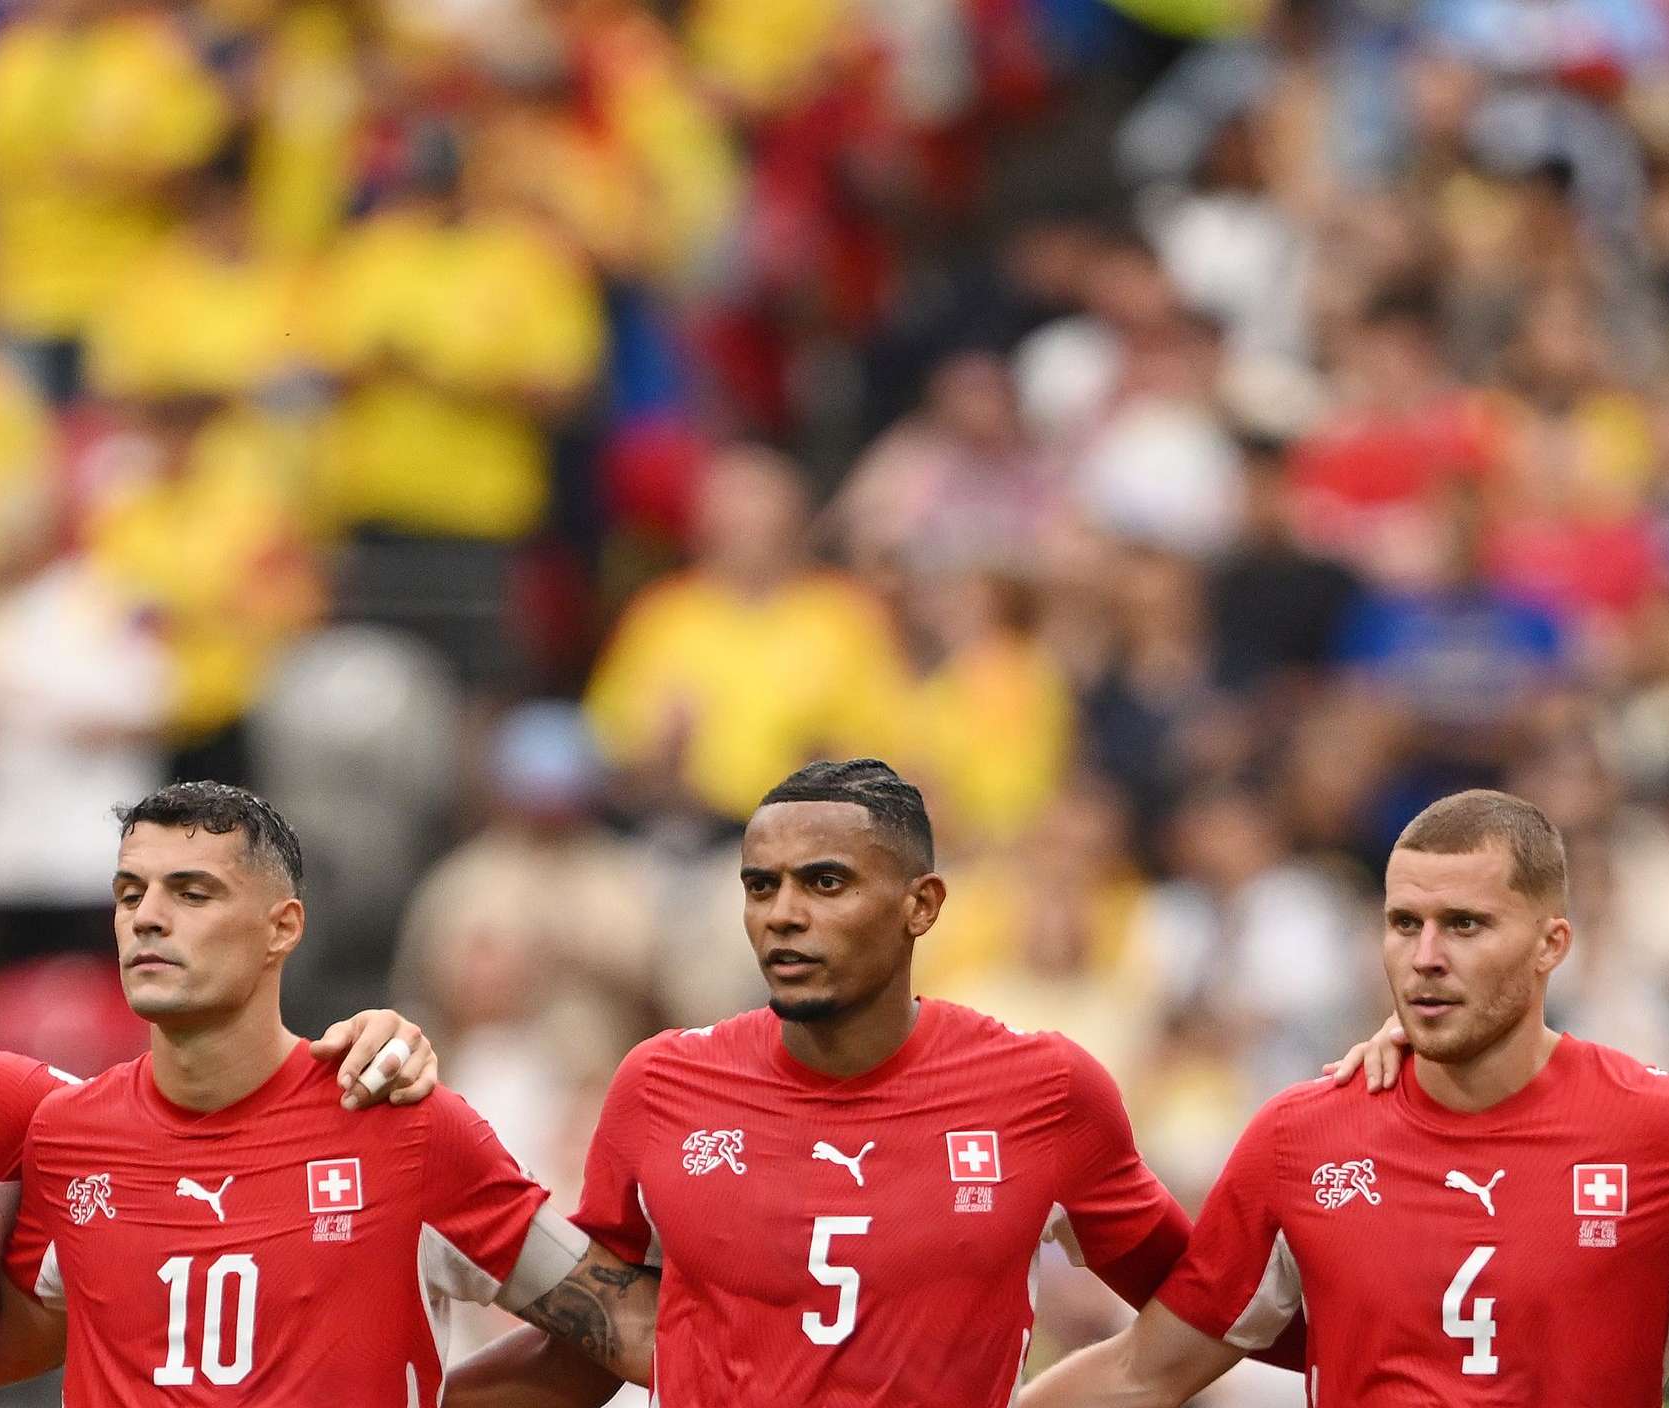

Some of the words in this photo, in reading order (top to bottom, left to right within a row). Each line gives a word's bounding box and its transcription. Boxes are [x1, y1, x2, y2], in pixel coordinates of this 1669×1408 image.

[153, 1253, 259, 1386] 10
[802, 1216, 873, 1346] 5
[1442, 1246, 1499, 1375] 4
